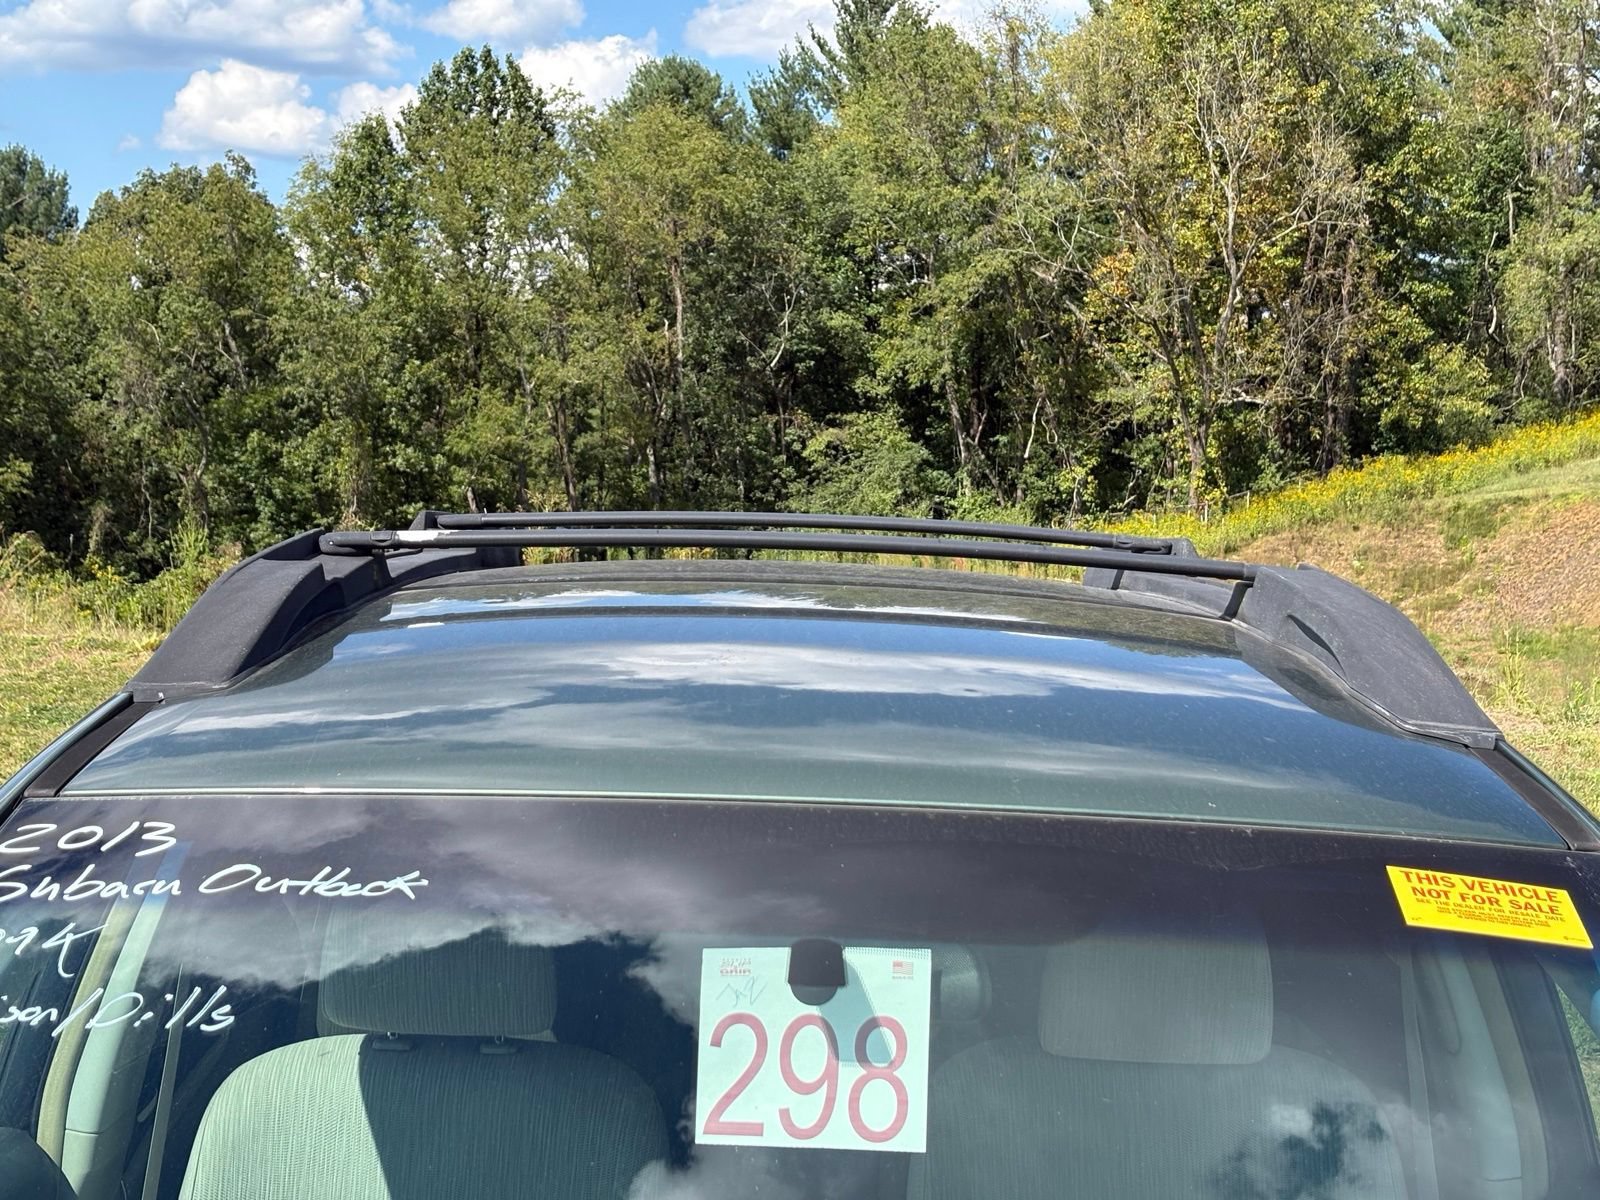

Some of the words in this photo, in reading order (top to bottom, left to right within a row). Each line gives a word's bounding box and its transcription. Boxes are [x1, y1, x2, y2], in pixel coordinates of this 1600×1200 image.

[0, 820, 177, 857] 2013
[0, 863, 182, 903] Subaru
[1400, 870, 1456, 889] THIS
[1460, 878, 1563, 904] VEHICLE
[1410, 886, 1451, 901] NOT
[1459, 892, 1503, 908] FOR
[1509, 899, 1563, 916] SALE
[1415, 897, 1432, 905] SEE
[1434, 899, 1451, 907] THE
[1453, 902, 1486, 912] DEALER
[1488, 906, 1506, 914] FOR
[1508, 909, 1541, 919] RESALE
[1544, 914, 1567, 923] DATE
[0, 984, 236, 1037] son/Dills
[702, 1011, 909, 1143] 298
